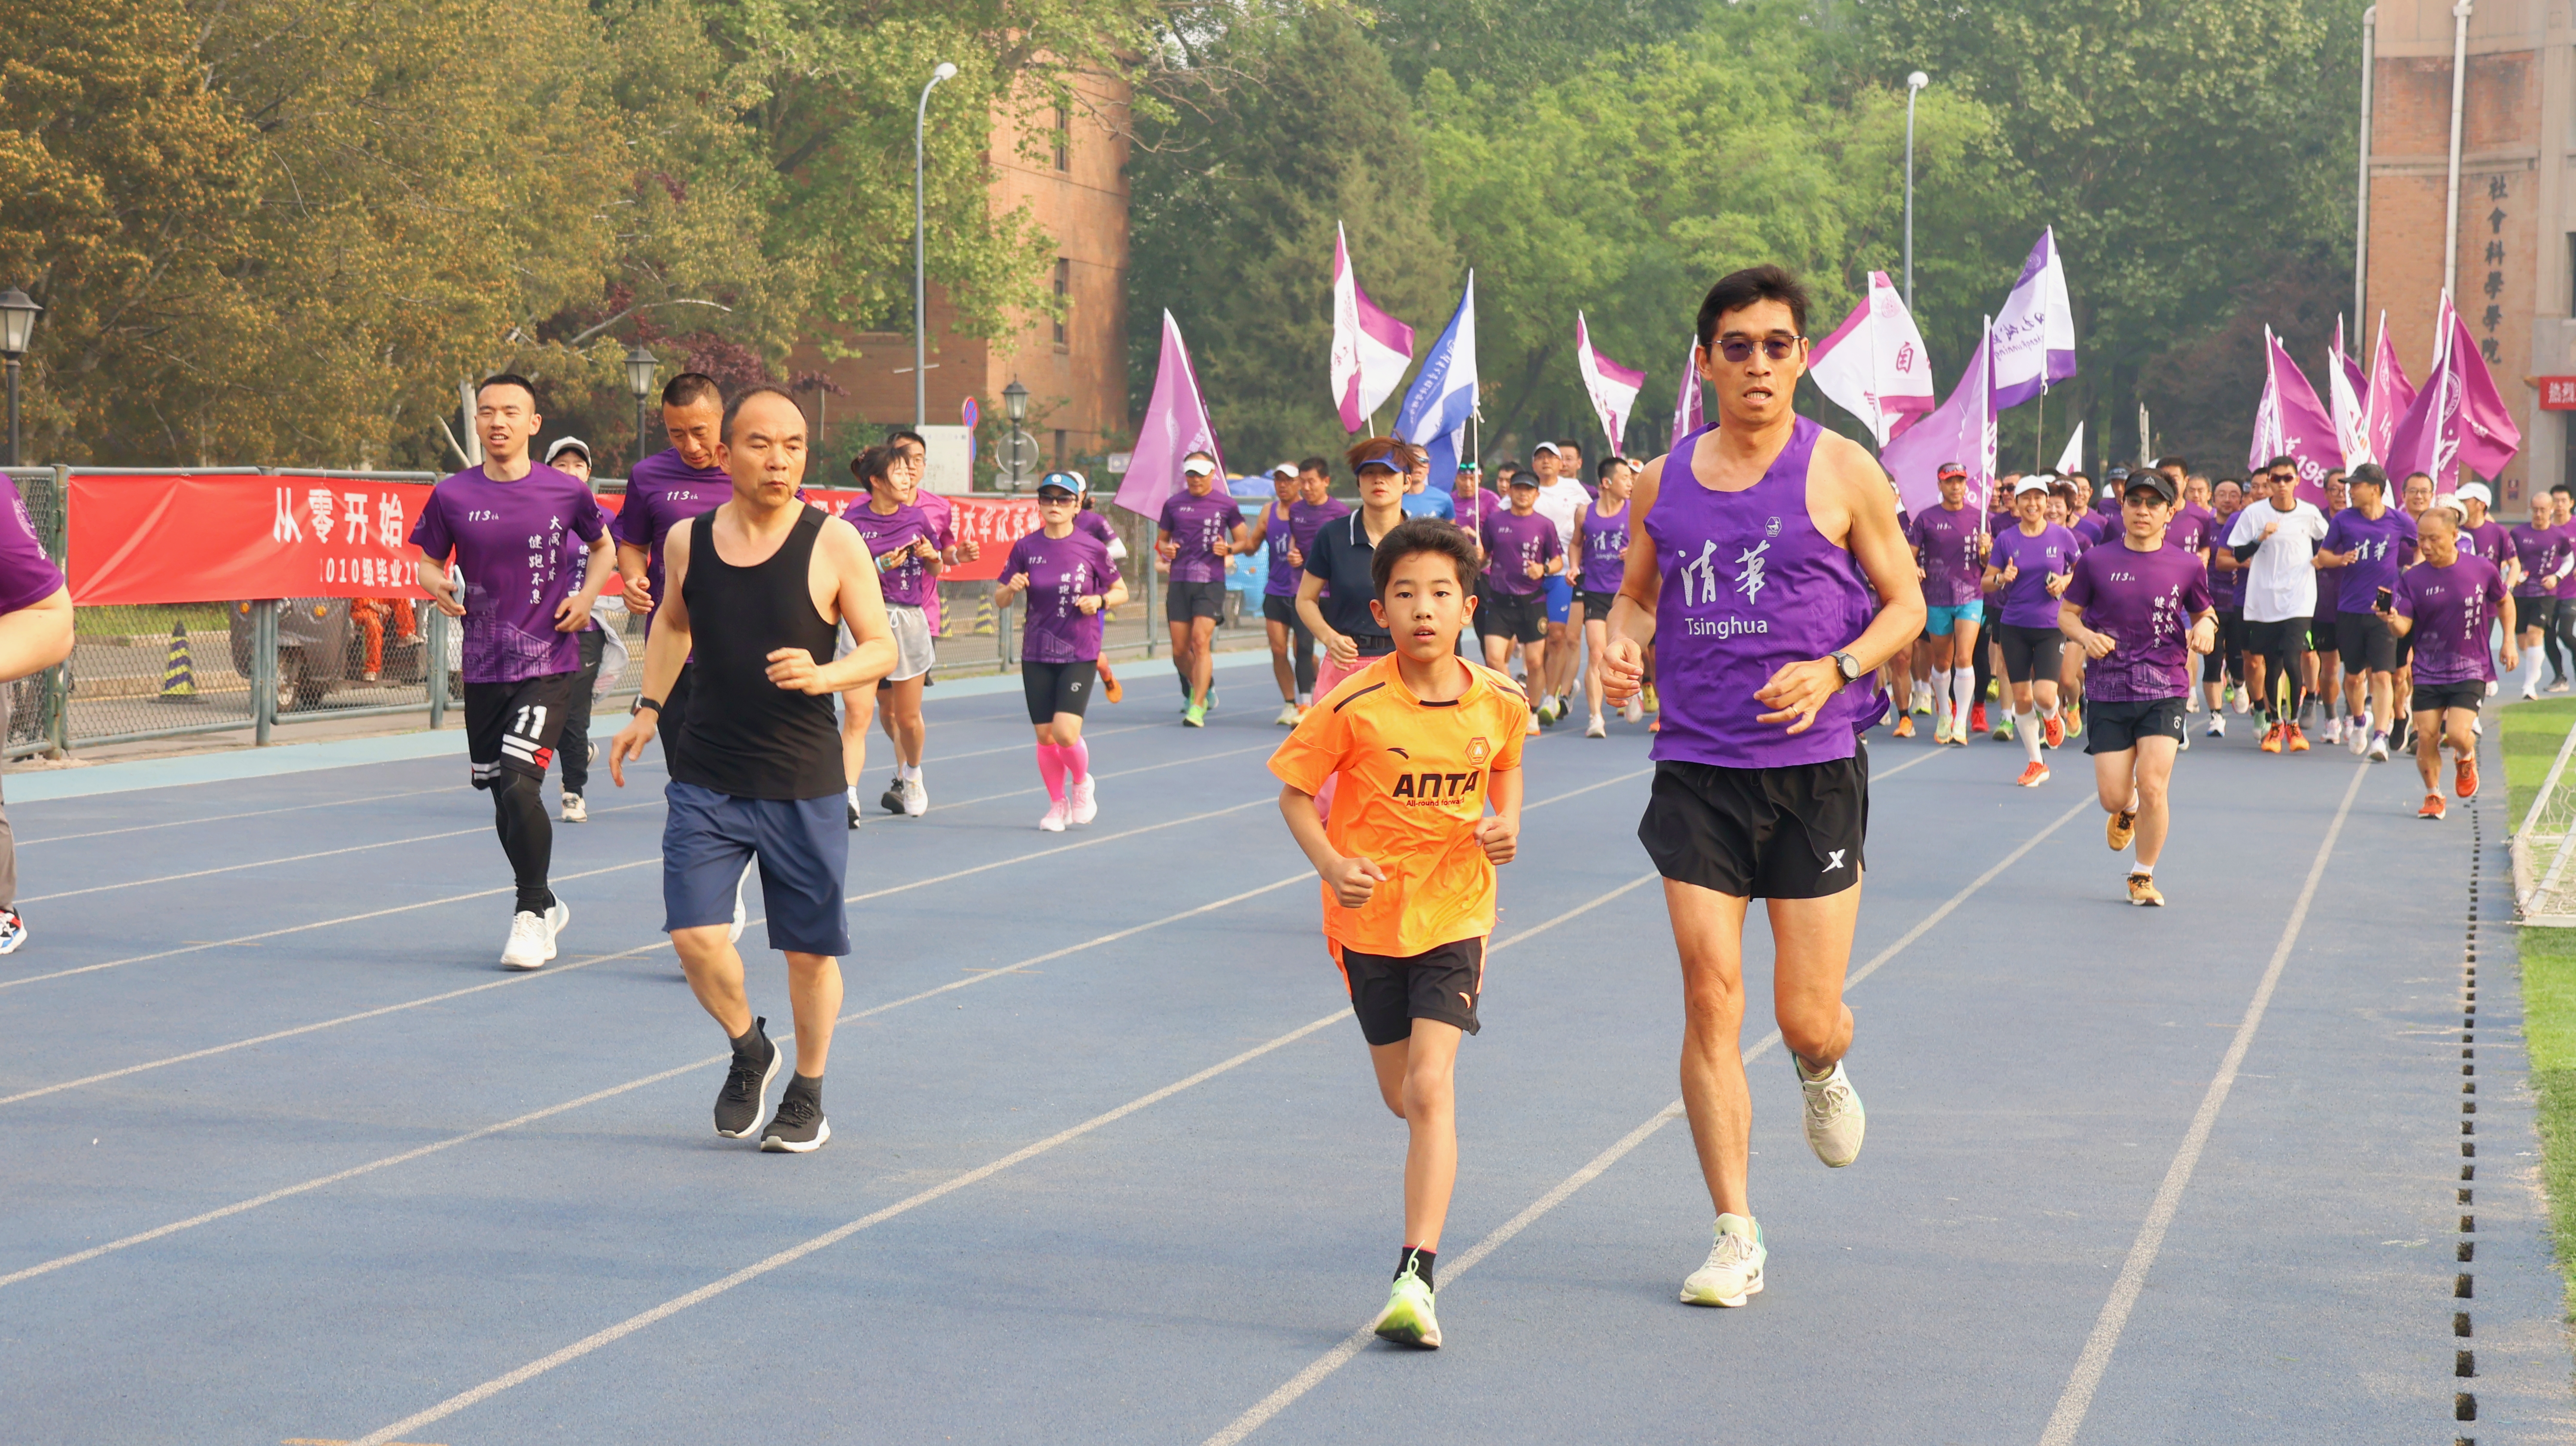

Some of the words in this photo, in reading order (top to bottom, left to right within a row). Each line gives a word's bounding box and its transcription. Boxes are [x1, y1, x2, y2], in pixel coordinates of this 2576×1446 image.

[667, 491, 698, 501] 113th
[273, 487, 404, 547] 从零开始
[529, 534, 544, 604] 健跑不息
[2111, 572, 2135, 581] 113th
[1685, 616, 1768, 639] Tsinghua
[2151, 595, 2165, 648] 健跑不息
[514, 705, 547, 740] 11
[1392, 771, 1479, 798] ANTA
